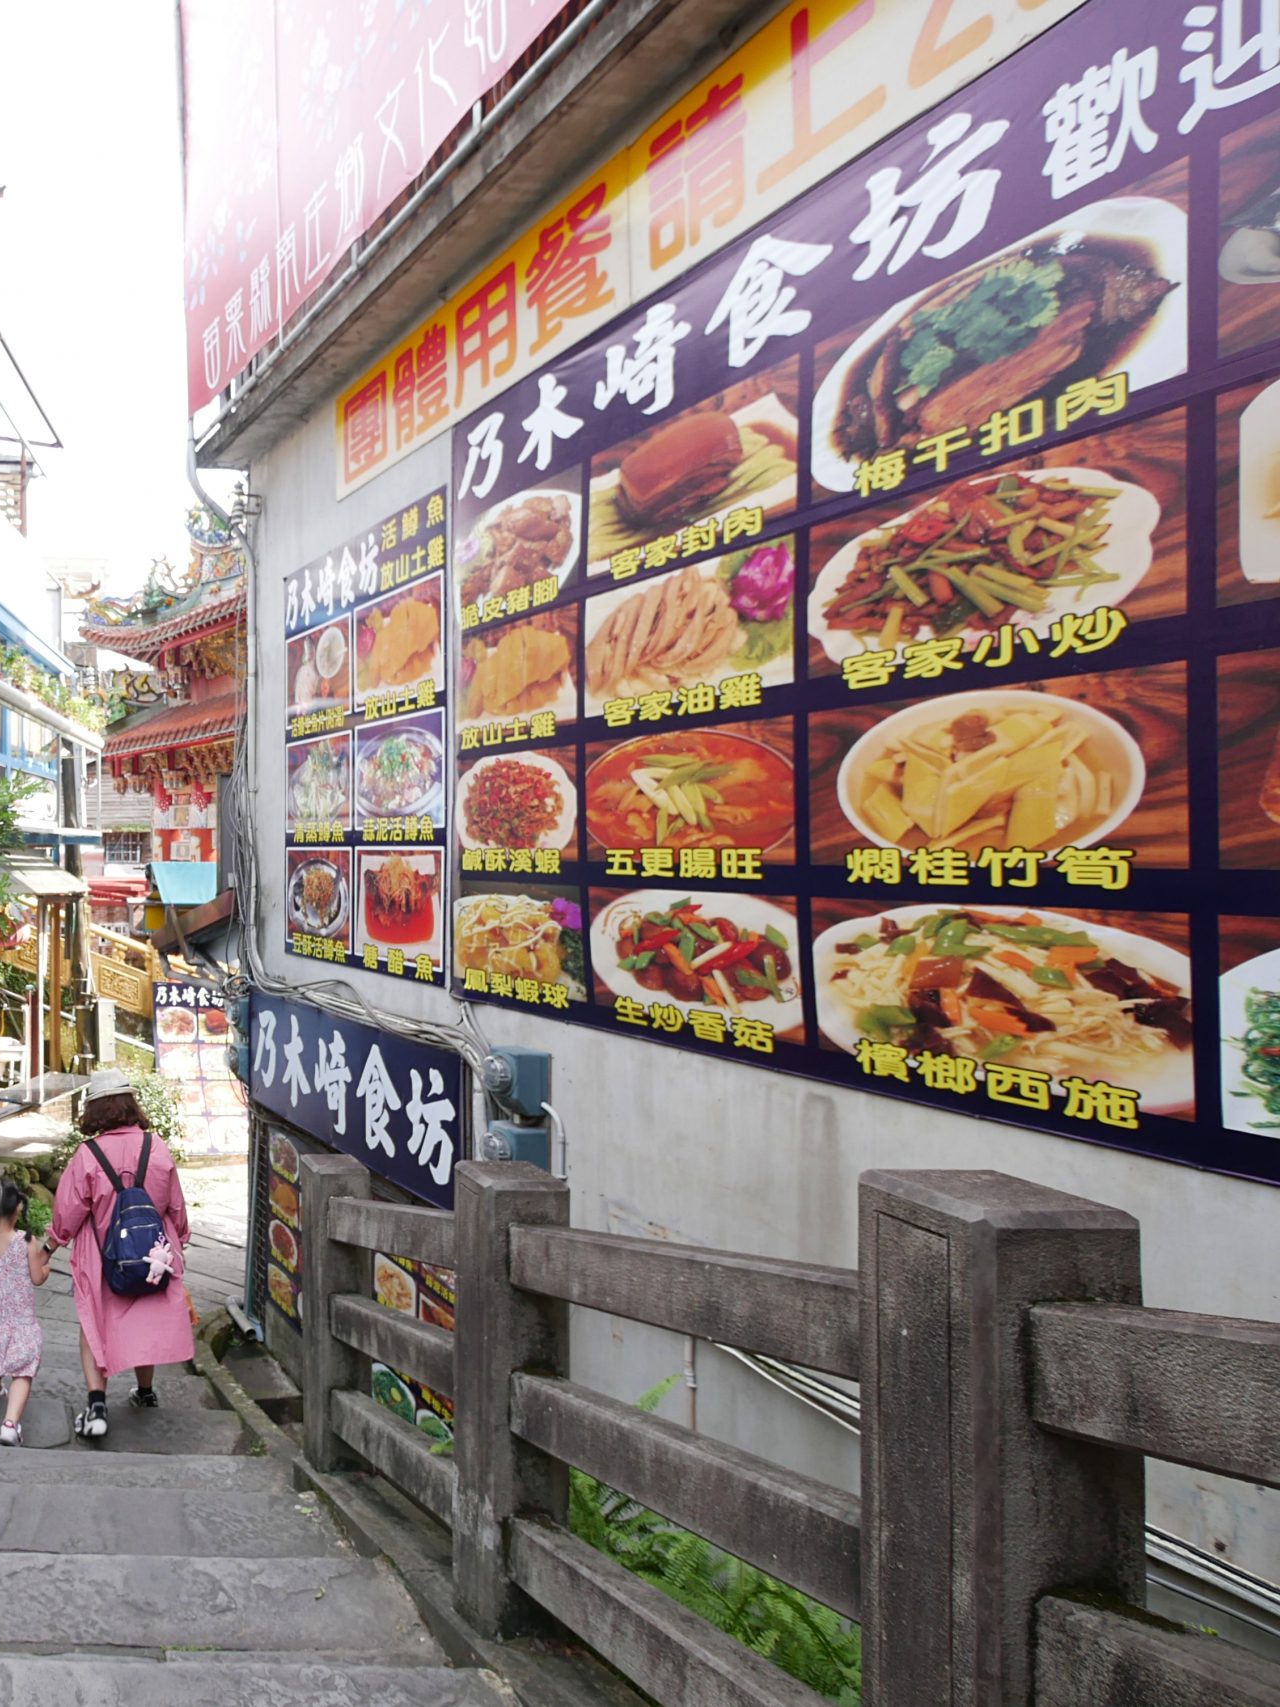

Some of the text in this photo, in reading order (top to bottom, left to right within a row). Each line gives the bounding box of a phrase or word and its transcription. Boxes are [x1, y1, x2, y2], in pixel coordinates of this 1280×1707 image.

[202, 0, 538, 389] 苗栗縣南庄鄉文化路
[852, 371, 1128, 496] 梅干扣肉
[380, 534, 445, 593] 放山土雞
[609, 506, 763, 580] 客家封肉
[286, 533, 379, 631] 乃木崎食坊
[460, 575, 559, 631] 脆皮豬腳
[842, 606, 1127, 689] 客家小炒
[364, 679, 436, 721] 放山土雞
[604, 673, 762, 728] 客家油雞
[461, 710, 556, 750] 放山土雞
[293, 822, 345, 843] 清蒸鱒魚
[362, 815, 434, 842] 蒜泥活鱒魚
[462, 848, 561, 875] 鹹酥溪蝦
[605, 847, 763, 880] 五更腸旺
[846, 846, 1134, 890] 燜桂竹筍
[363, 943, 434, 982] 糖醋魚
[463, 968, 570, 1010] 鳳梨蝦球
[614, 996, 774, 1054] 生炒香菇
[254, 1010, 456, 1186] 乃木崎食坊
[854, 1039, 1139, 1130] 檳榔西施
